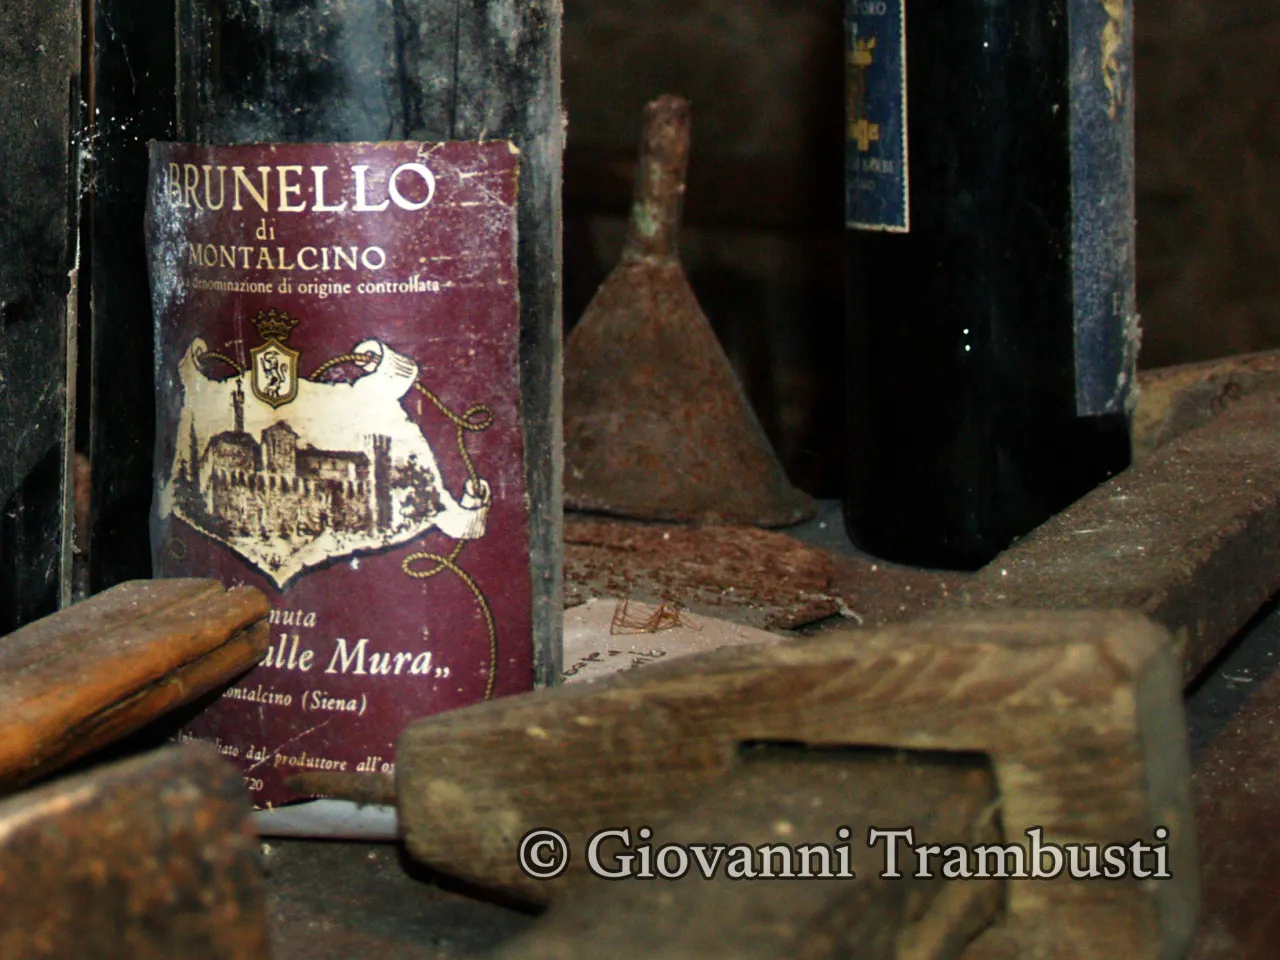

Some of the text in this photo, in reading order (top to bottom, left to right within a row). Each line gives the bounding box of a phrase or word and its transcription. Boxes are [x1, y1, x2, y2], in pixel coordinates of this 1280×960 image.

[168, 161, 437, 214] BRUNELLO
[255, 218, 276, 241] di
[188, 243, 387, 272] MONTALCINO
[193, 273, 273, 294] denominazione
[278, 278, 293, 295] di
[297, 277, 352, 299] origine
[356, 275, 441, 295] controllata
[269, 608, 317, 628] nuta
[222, 684, 367, 717] ontalcino (Siena)
[245, 743, 267, 762] dal
[274, 751, 348, 772] produttore
